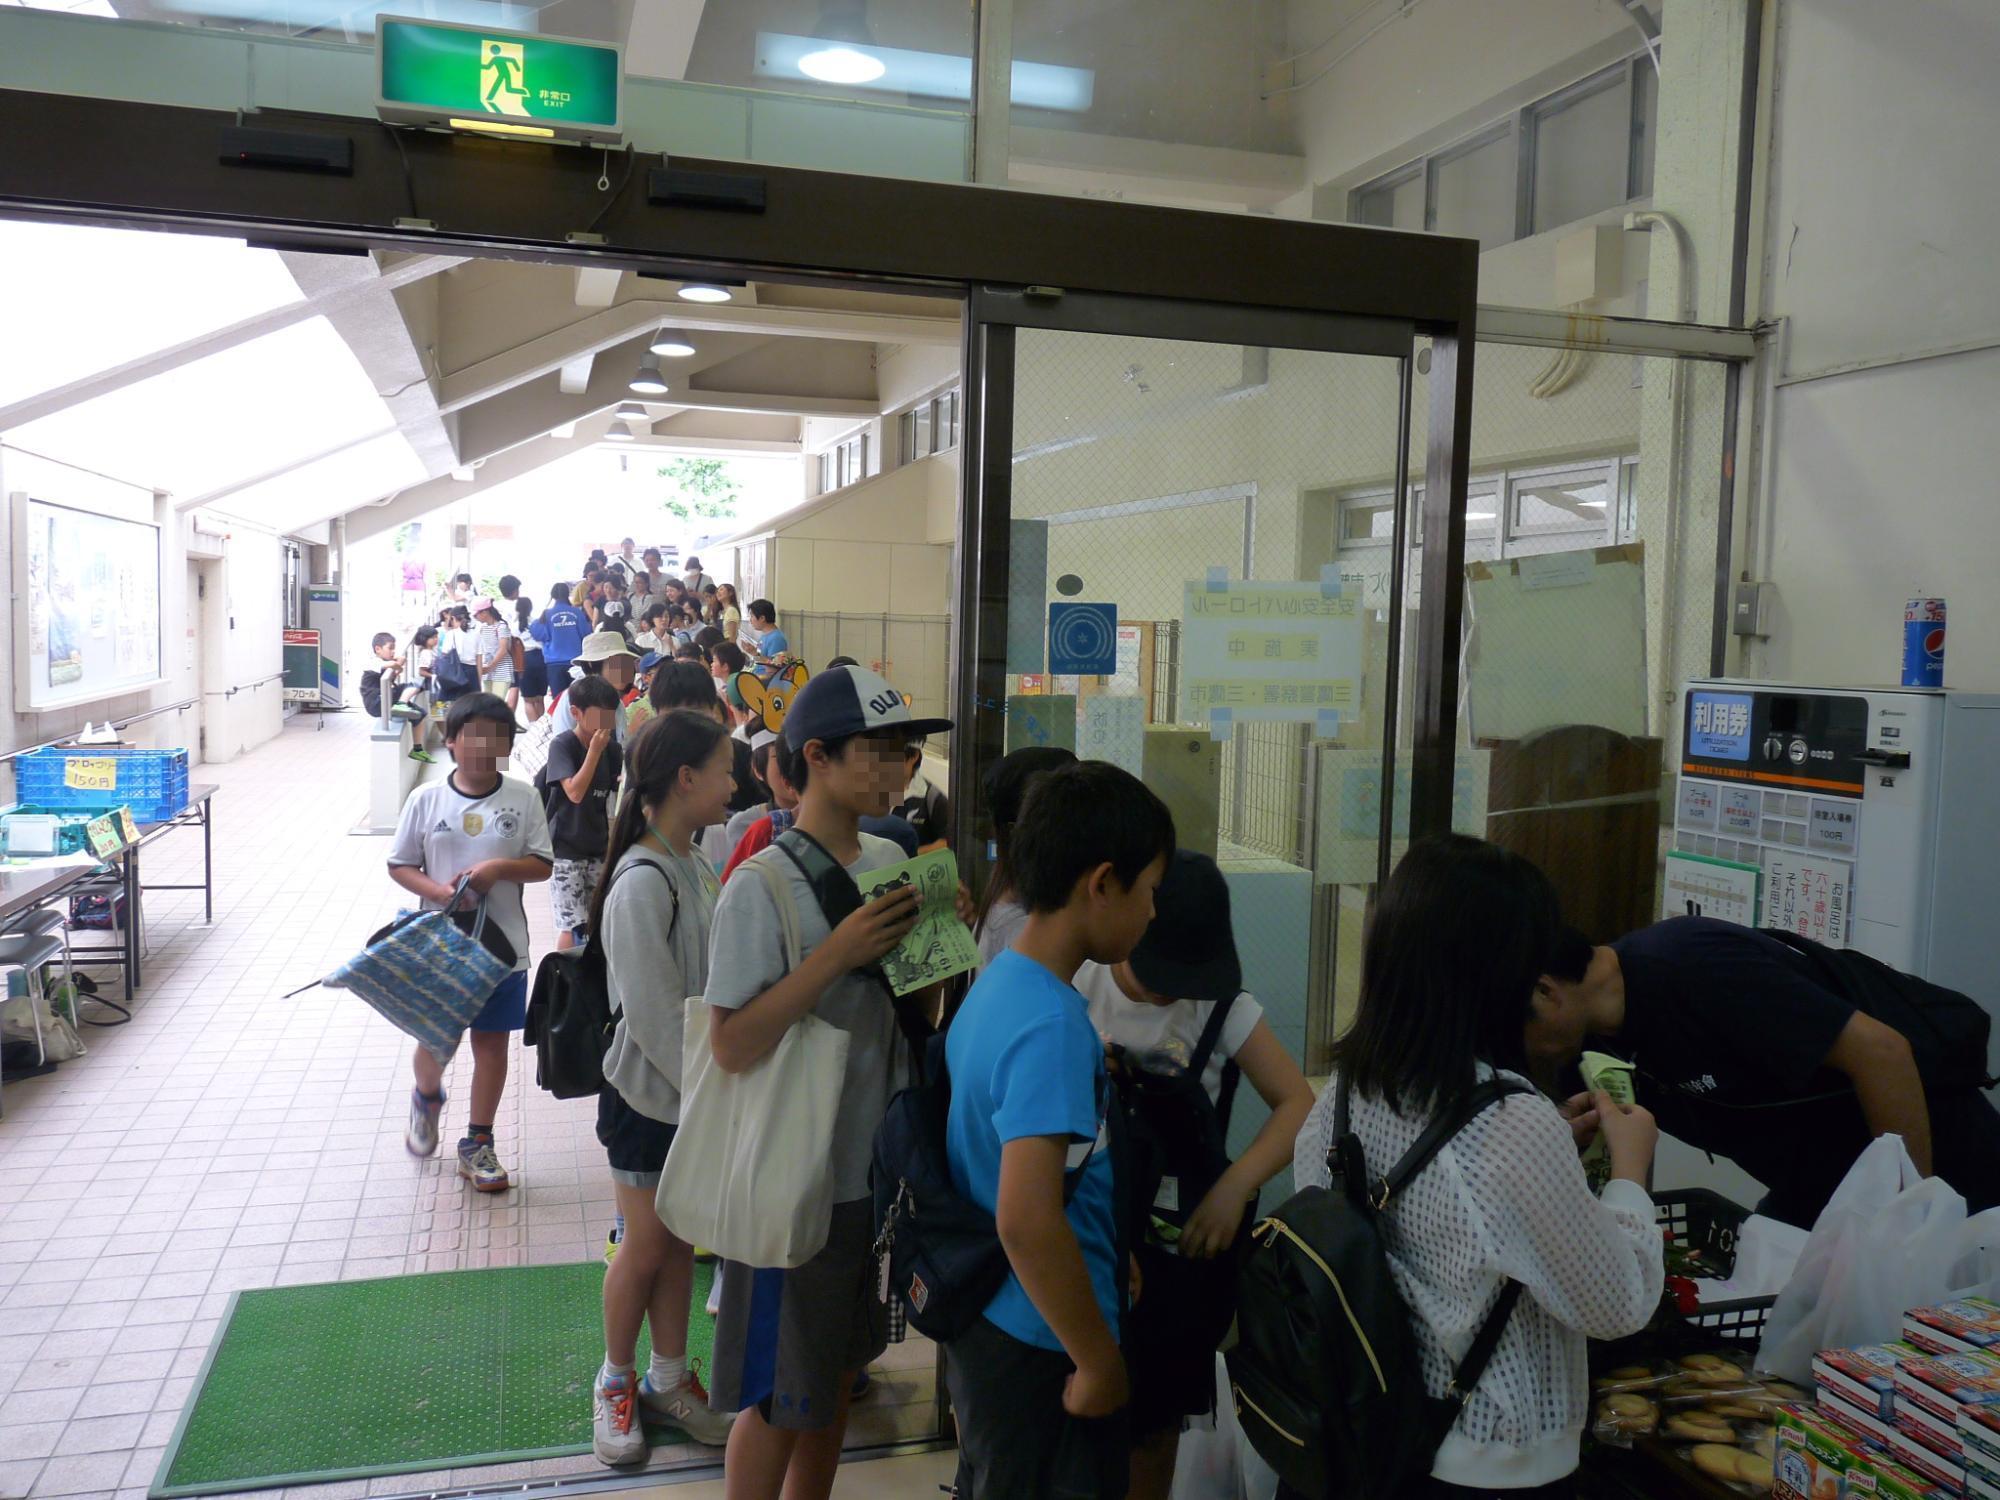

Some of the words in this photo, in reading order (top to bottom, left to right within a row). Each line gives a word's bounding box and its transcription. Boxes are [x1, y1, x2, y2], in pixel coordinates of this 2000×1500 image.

[539, 89, 571, 102] 非常口
[1694, 701, 1749, 737] 利用券
[74, 773, 110, 788] 150円
[1819, 829, 1843, 841] 100円
